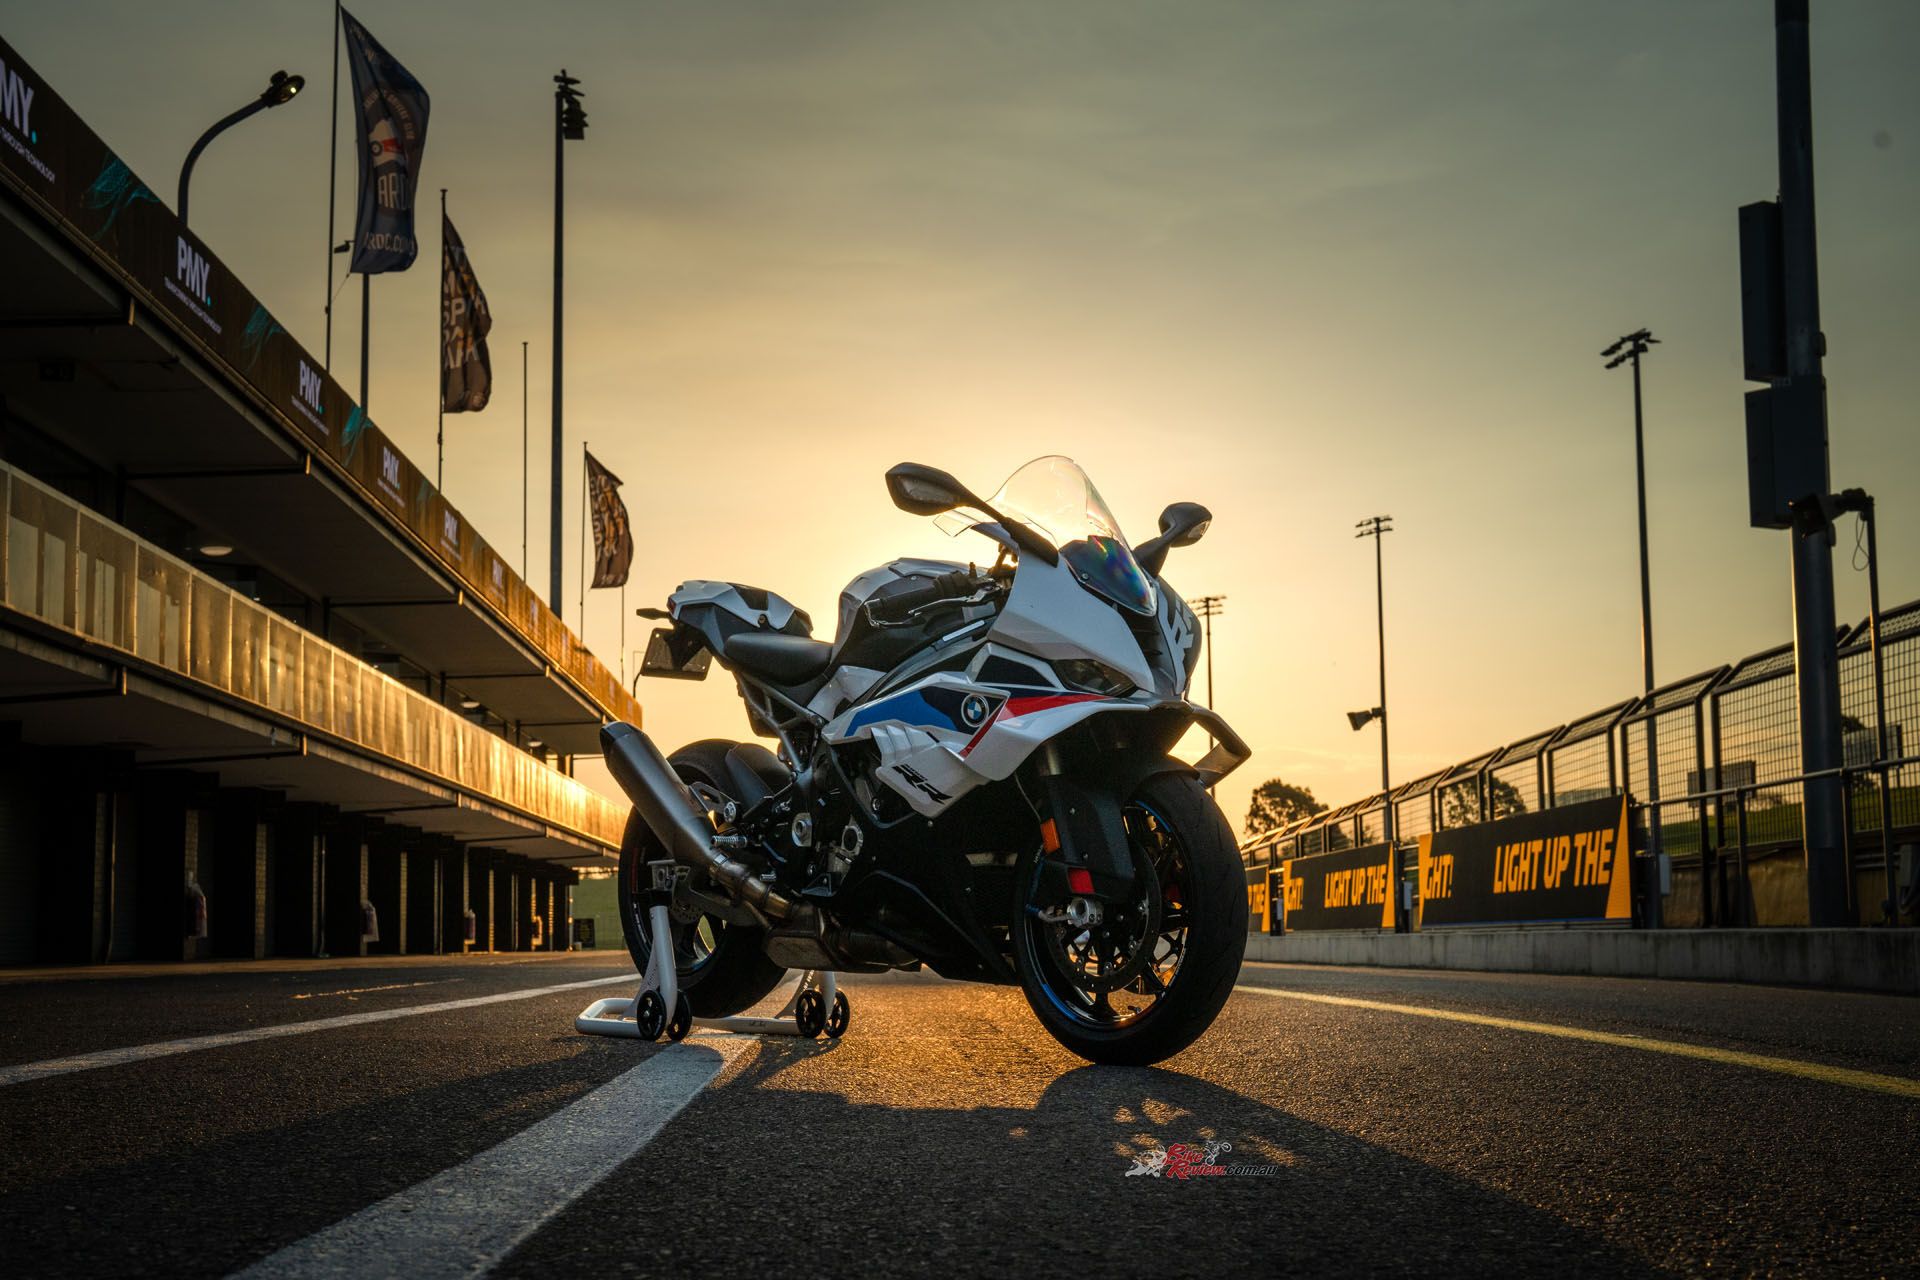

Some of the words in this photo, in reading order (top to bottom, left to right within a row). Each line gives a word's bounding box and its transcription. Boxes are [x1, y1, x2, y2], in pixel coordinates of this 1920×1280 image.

[1423, 853, 1455, 900] GHT!
[1493, 839, 1544, 894] LIGHT
[1543, 835, 1571, 890] UP
[1573, 828, 1614, 887] THE
[1323, 869, 1352, 909] LIGHT
[1350, 867, 1367, 907] UP
[1365, 863, 1387, 905] THE
